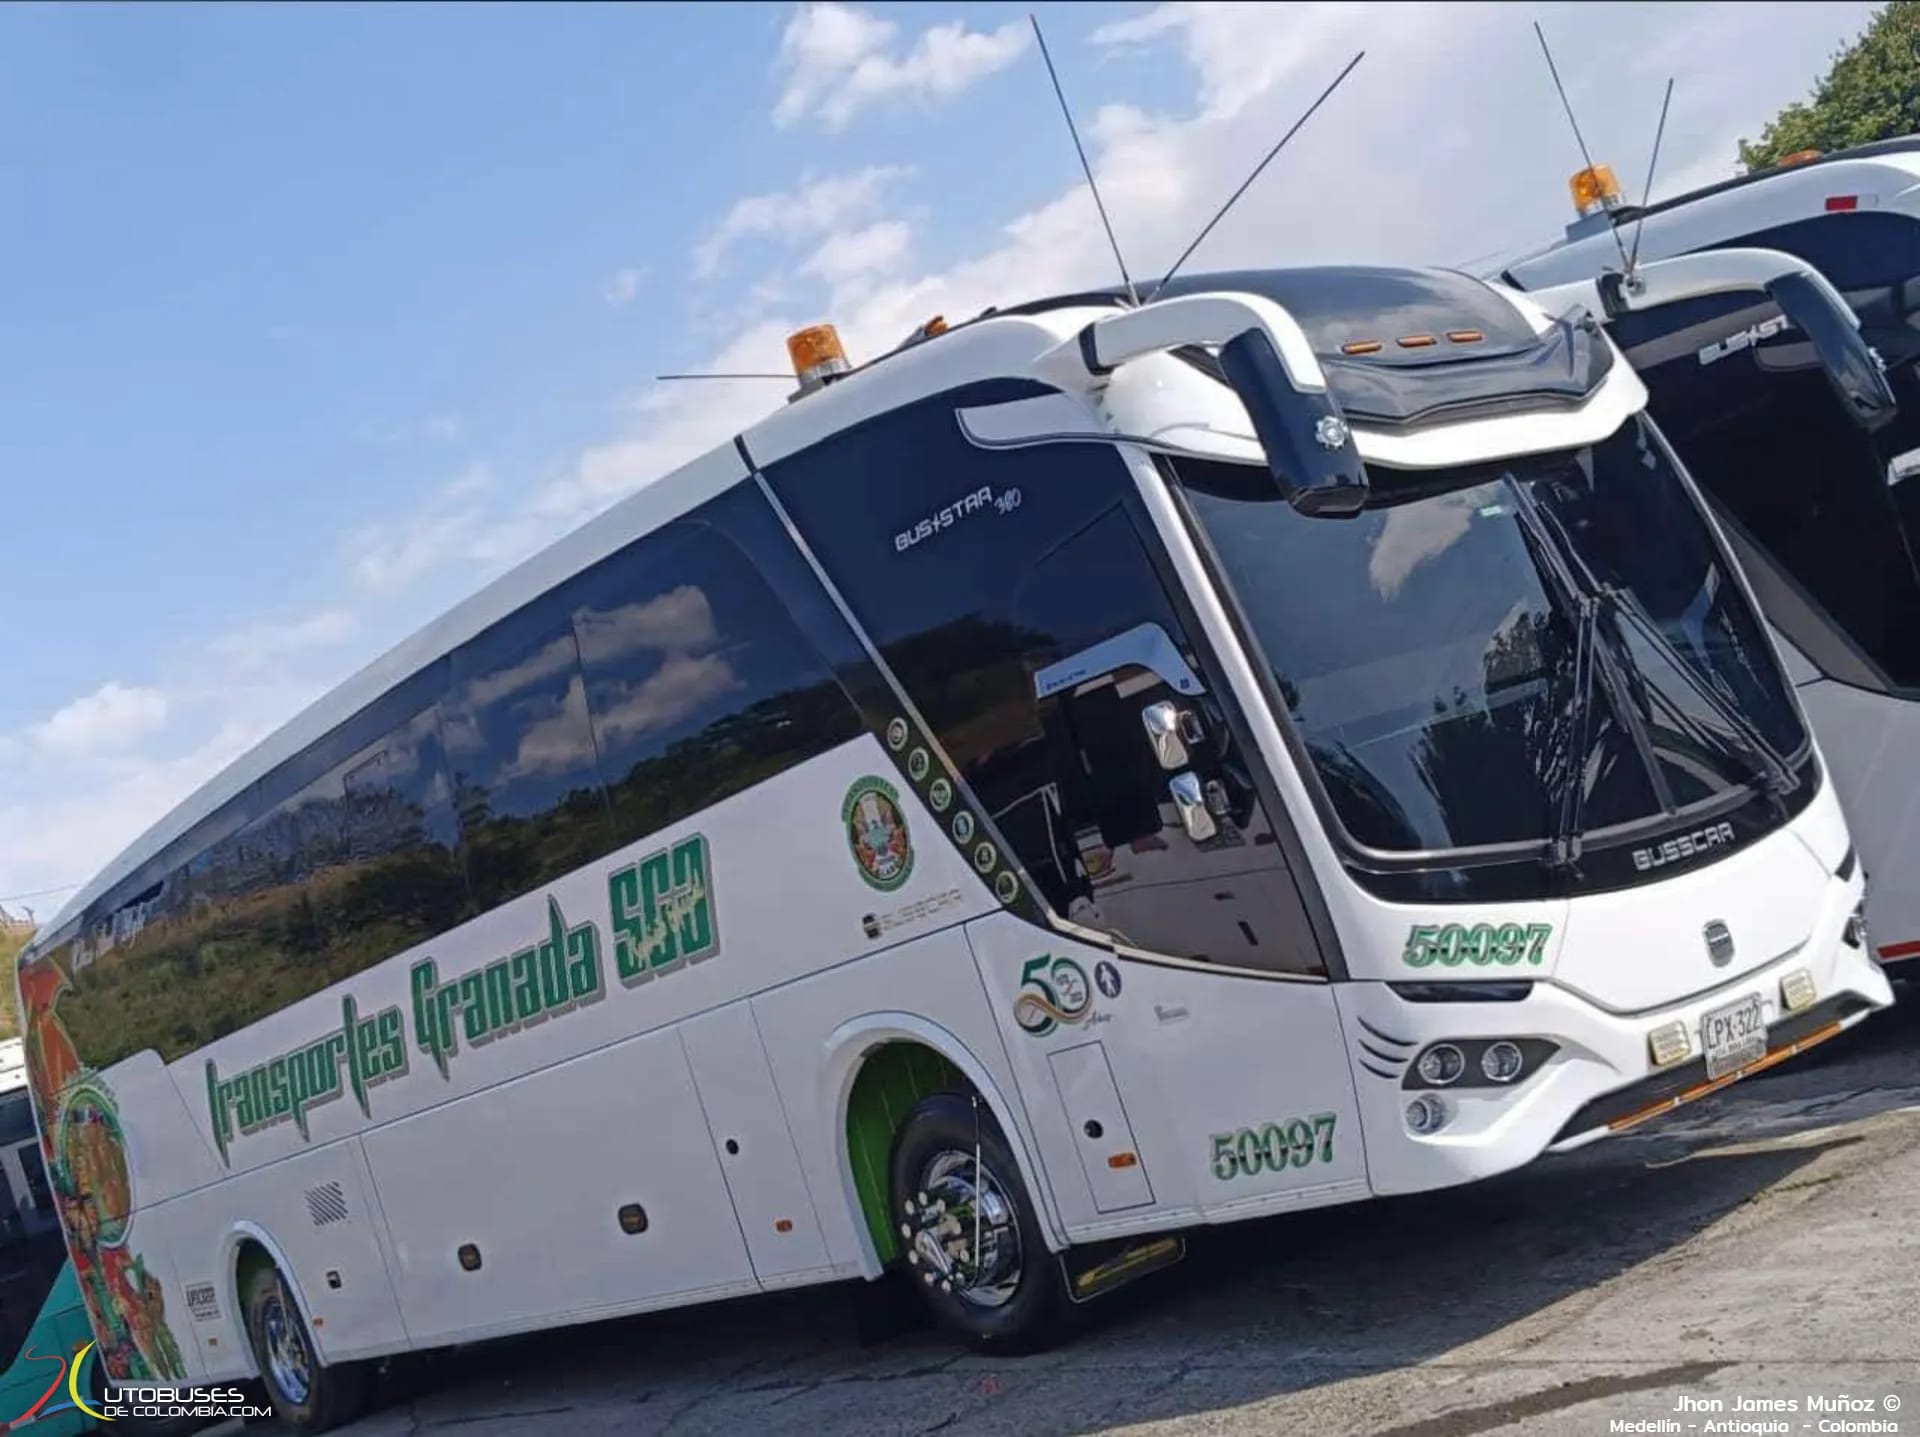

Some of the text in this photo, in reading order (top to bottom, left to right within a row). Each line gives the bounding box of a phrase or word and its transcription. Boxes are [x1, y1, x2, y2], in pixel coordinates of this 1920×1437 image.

[1632, 821, 1735, 871] BUSSCAR
[1401, 922, 1553, 968] 50097
[205, 992, 410, 1169] Transportes
[410, 892, 607, 1083] Granada
[1208, 1111, 1338, 1181] 50097
